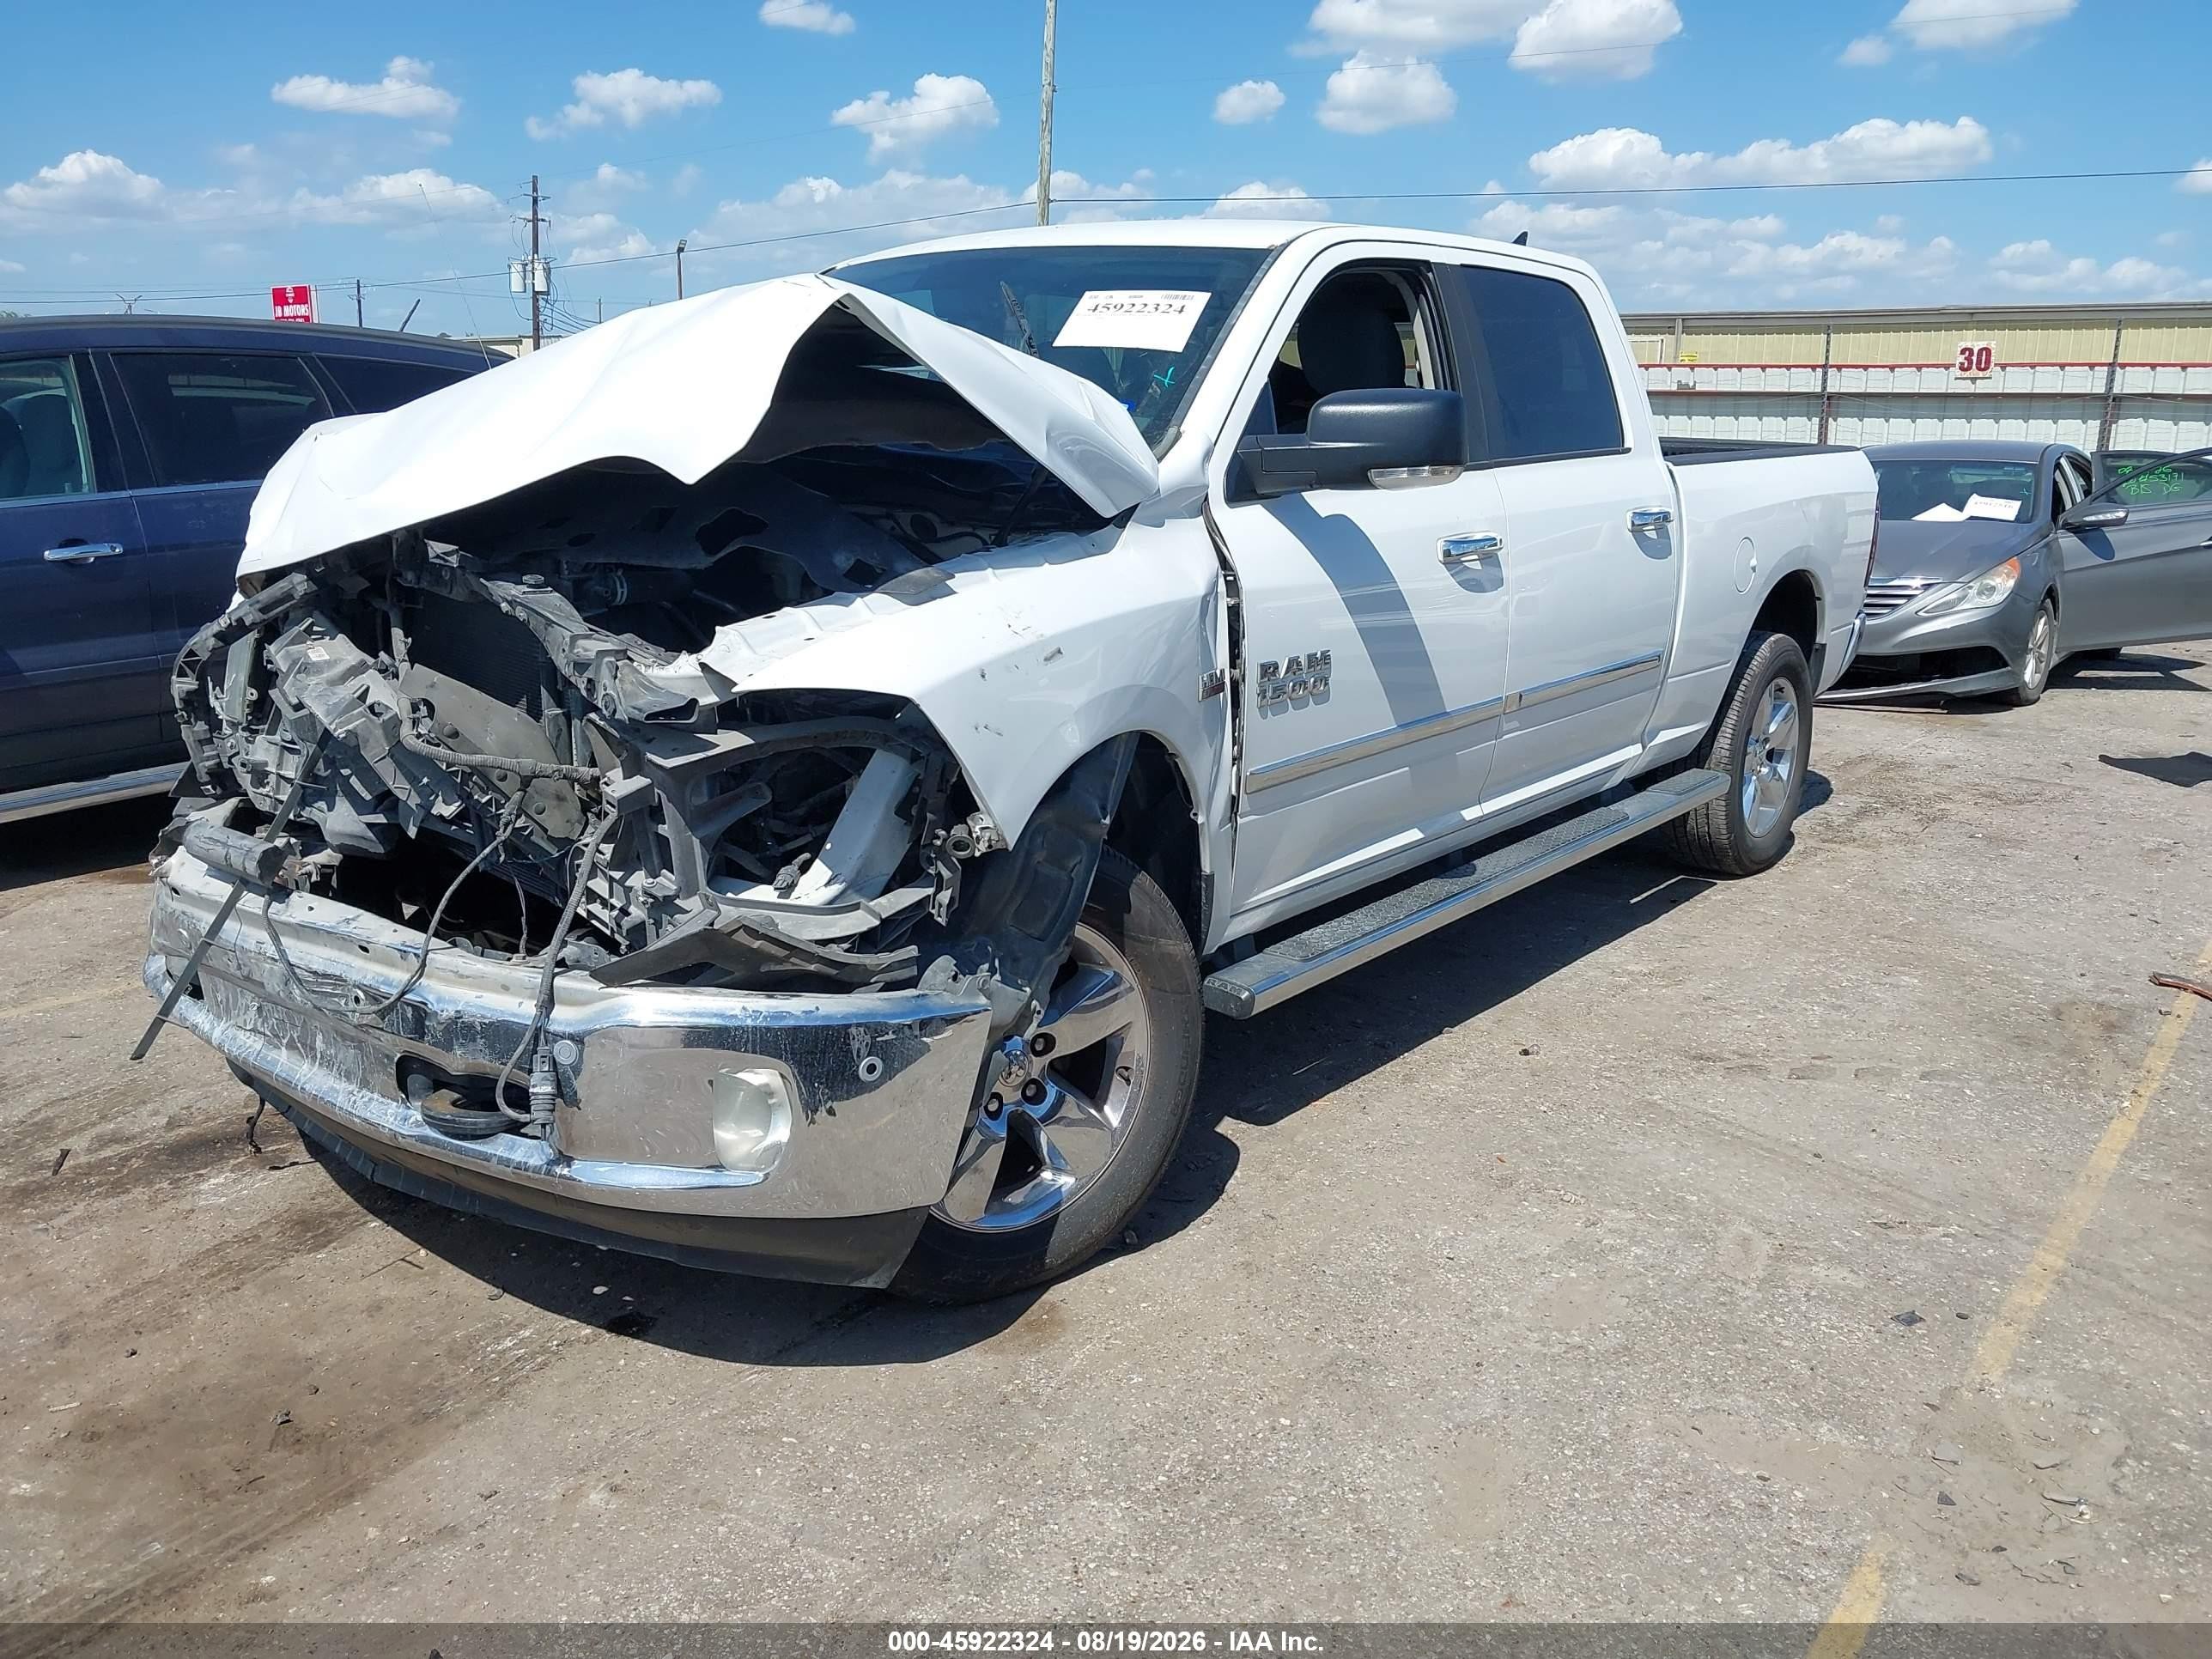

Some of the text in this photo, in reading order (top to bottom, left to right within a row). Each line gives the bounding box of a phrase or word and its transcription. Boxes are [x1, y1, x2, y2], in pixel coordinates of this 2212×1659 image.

[283, 304, 309, 317] MOTORS
[1087, 302, 1186, 314] 45922324
[1959, 347, 1992, 372] 30
[1257, 649, 1331, 684] RAM
[1257, 676, 1330, 708] 1500
[1205, 977, 1243, 998] RAM
